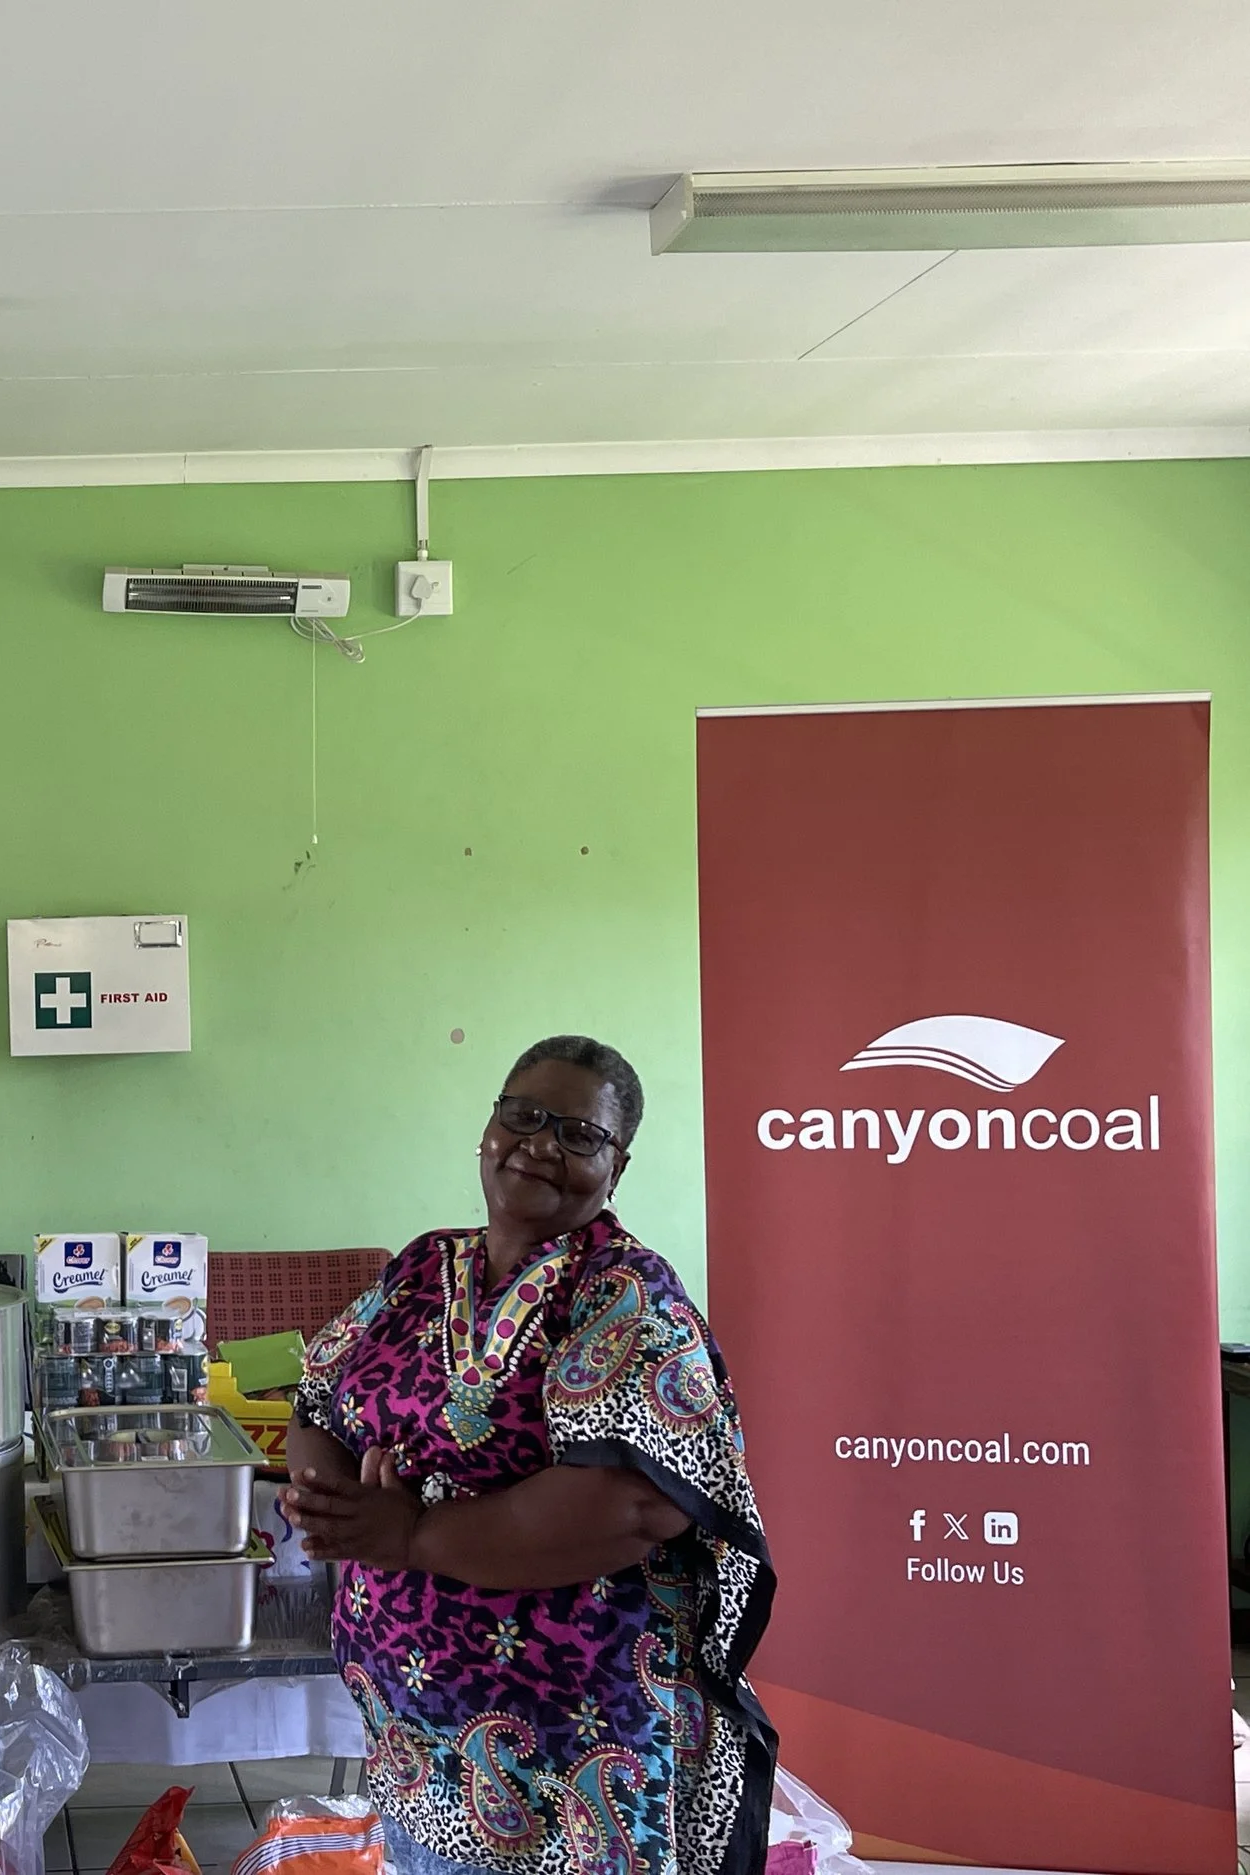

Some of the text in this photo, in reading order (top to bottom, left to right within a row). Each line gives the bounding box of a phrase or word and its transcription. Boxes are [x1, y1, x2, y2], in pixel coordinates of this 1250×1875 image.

[100, 992, 168, 1003] FIRST AID
[757, 1094, 1160, 1165] canyoncoal
[53, 1268, 105, 1288] Creamel
[141, 1268, 193, 1288] Creamel
[835, 1432, 1091, 1468] canyoncoal.com
[907, 1557, 1025, 1585] Follow Us
